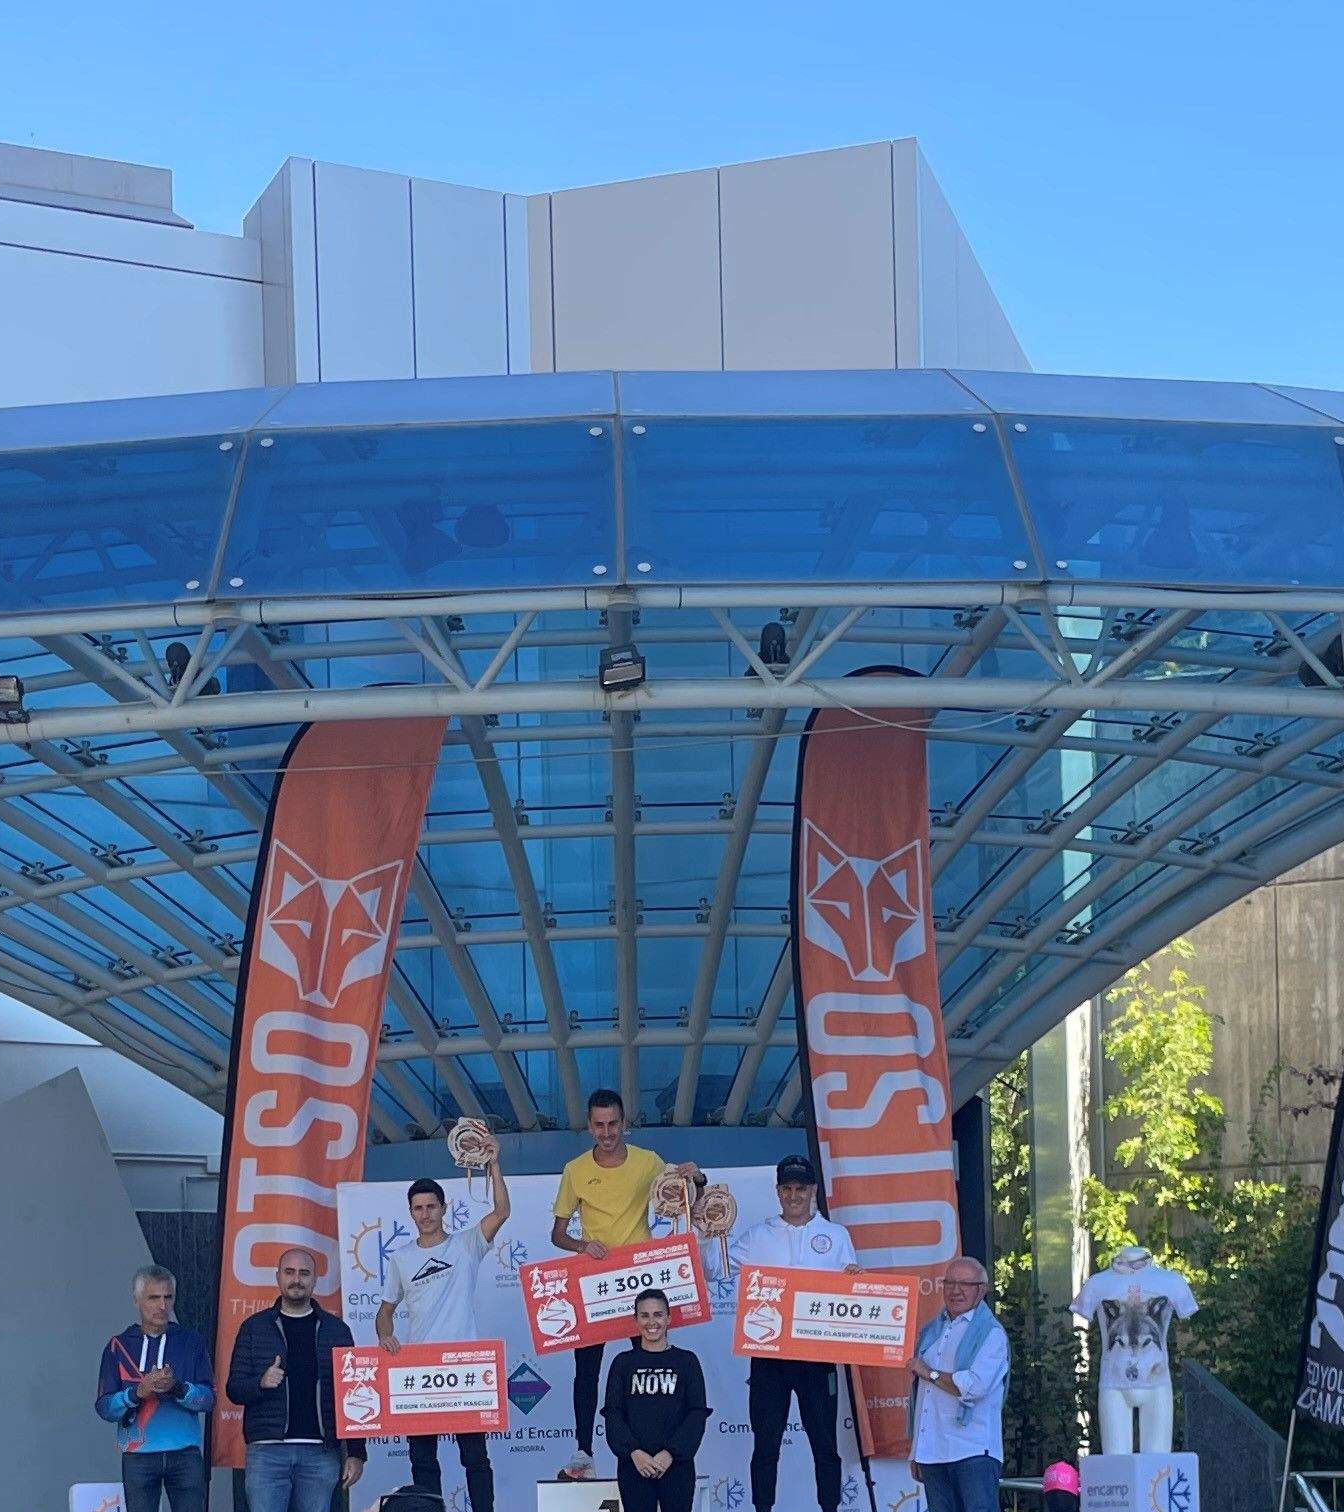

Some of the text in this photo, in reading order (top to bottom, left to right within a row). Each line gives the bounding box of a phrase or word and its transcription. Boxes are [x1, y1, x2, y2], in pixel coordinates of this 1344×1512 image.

[805, 992, 957, 1267] OTSO
[233, 1010, 371, 1297] OTSO
[615, 1273, 653, 1293] 300
[677, 1263, 692, 1279] €
[828, 1302, 862, 1319] 100
[891, 1304, 904, 1321] €
[422, 1373, 458, 1389] 200
[482, 1369, 495, 1386] €
[631, 1373, 678, 1395] NOW
[515, 1425, 576, 1441] d'Encam
[719, 1420, 754, 1434] Com
[509, 1445, 546, 1454] ANDORRA
